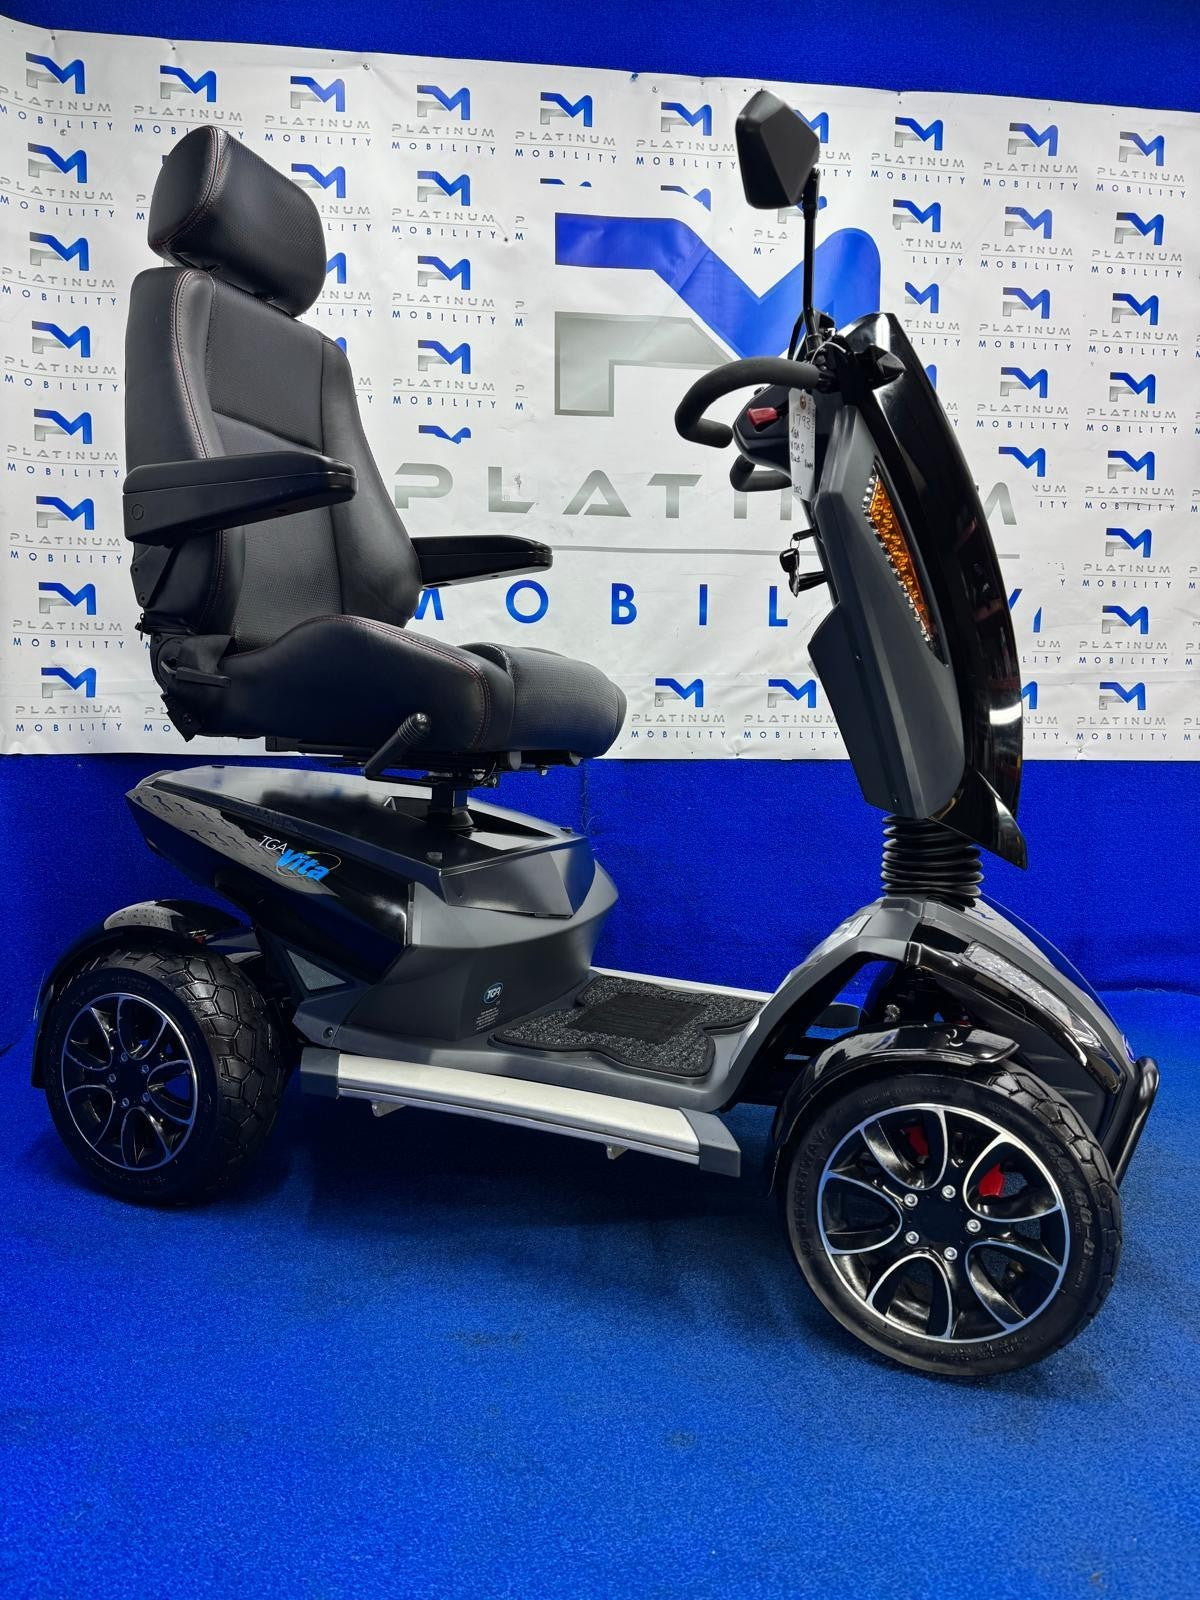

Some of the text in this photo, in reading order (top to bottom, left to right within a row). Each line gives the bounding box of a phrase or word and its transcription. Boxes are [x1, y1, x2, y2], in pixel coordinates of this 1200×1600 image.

[134, 105, 243, 122] PLATINUM
[265, 114, 370, 129] PLATINUM
[392, 123, 495, 137] PLATINUM
[265, 133, 371, 146] MOBILITY
[515, 131, 615, 146] PLATINUM
[392, 142, 496, 155] MOBILITY
[636, 139, 735, 152] PLATINUM
[515, 149, 617, 163] MOBILITY
[872, 153, 964, 168] PLATINUM
[636, 156, 736, 170] MOBILITY
[983, 161, 1078, 174] PLATINUM
[871, 170, 965, 184] MOBILITY
[1097, 167, 1185, 182] PLATINUM
[0, 176, 113, 201] PLATINUM
[982, 179, 1078, 191] MOBILITY
[1096, 184, 1186, 197] MOBILITY
[0, 196, 114, 218] MOBILITY
[392, 208, 495, 222] PLATINUM
[392, 225, 496, 238] MOBILITY
[981, 244, 1073, 255] PLATINUM
[1092, 250, 1182, 261] PLATINUM
[980, 260, 1073, 271] MOBILITY
[1091, 266, 1182, 277] MOBILITY
[2, 267, 115, 288] PLATINUM
[2, 285, 116, 306] MOBILITY
[392, 293, 495, 307] PLATINUM
[392, 311, 496, 325] MOBILITY
[979, 324, 1071, 335] PLATINUM
[1089, 329, 1178, 341] PLATINUM
[978, 341, 1071, 351] MOBILITY
[1088, 346, 1179, 357] MOBILITY
[5, 356, 117, 375] PLATINUM
[5, 375, 118, 392] MOBILITY
[393, 378, 495, 391] PLATINUM
[393, 396, 496, 408] MOBILITY
[976, 403, 1068, 415] PLATINUM
[1087, 408, 1176, 418] PLATINUM
[976, 420, 1069, 430] MOBILITY
[1086, 424, 1178, 434] MOBILITY
[7, 445, 118, 461] PLATINUM
[8, 463, 119, 478] MOBILITY
[1085, 487, 1175, 496] PLATINUM
[1085, 502, 1175, 511] MOBILITY
[10, 533, 120, 547] PLATINUM
[11, 551, 122, 564] MOBILITY
[1083, 564, 1171, 573] PLATINUM
[1082, 580, 1171, 589] MOBILITY
[13, 620, 122, 631] PLATINUM
[13, 638, 124, 648] MOBILITY
[1079, 641, 1168, 650] PLATINUM
[16, 705, 121, 714] PLATINUM
[632, 715, 725, 723] PLATINUM
[744, 715, 836, 723] PLATINUM
[1077, 717, 1166, 725] PLATINUM
[16, 723, 121, 732] MOBILITY
[631, 731, 726, 739] MOBILITY
[744, 731, 838, 740] MOBILITY
[1077, 733, 1167, 741] MOBILITY
[259, 835, 288, 854] TGA
[275, 849, 330, 881] Vita
[486, 986, 501, 1000] TGA
